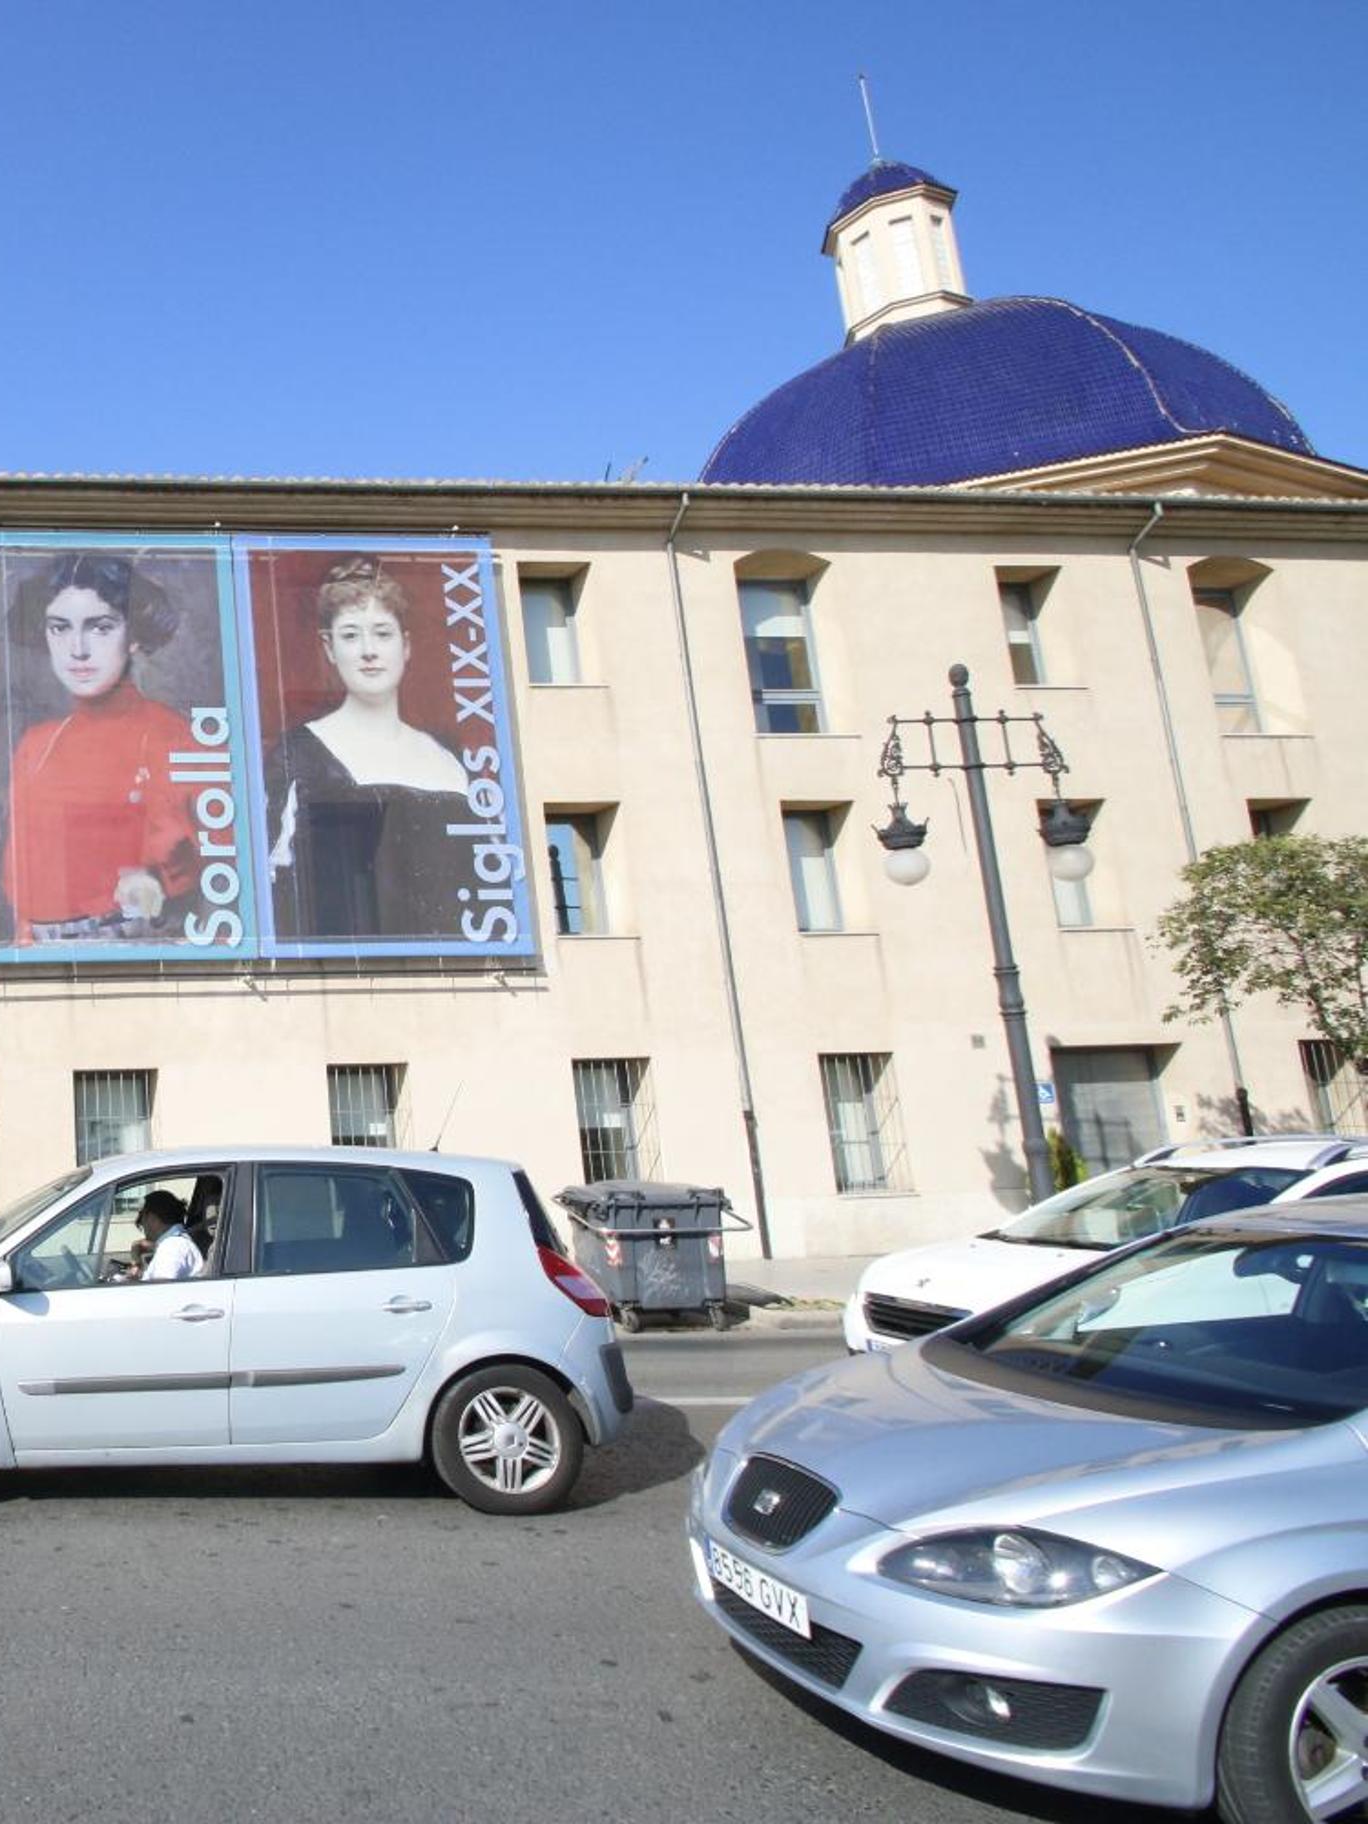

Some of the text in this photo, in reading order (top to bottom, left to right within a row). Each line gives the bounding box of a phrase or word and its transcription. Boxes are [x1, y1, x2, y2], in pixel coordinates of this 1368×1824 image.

[169, 707, 243, 947] Sorolla
[442, 564, 525, 944] Siglos XIX-XX
[760, 1578, 801, 1629] GVX
